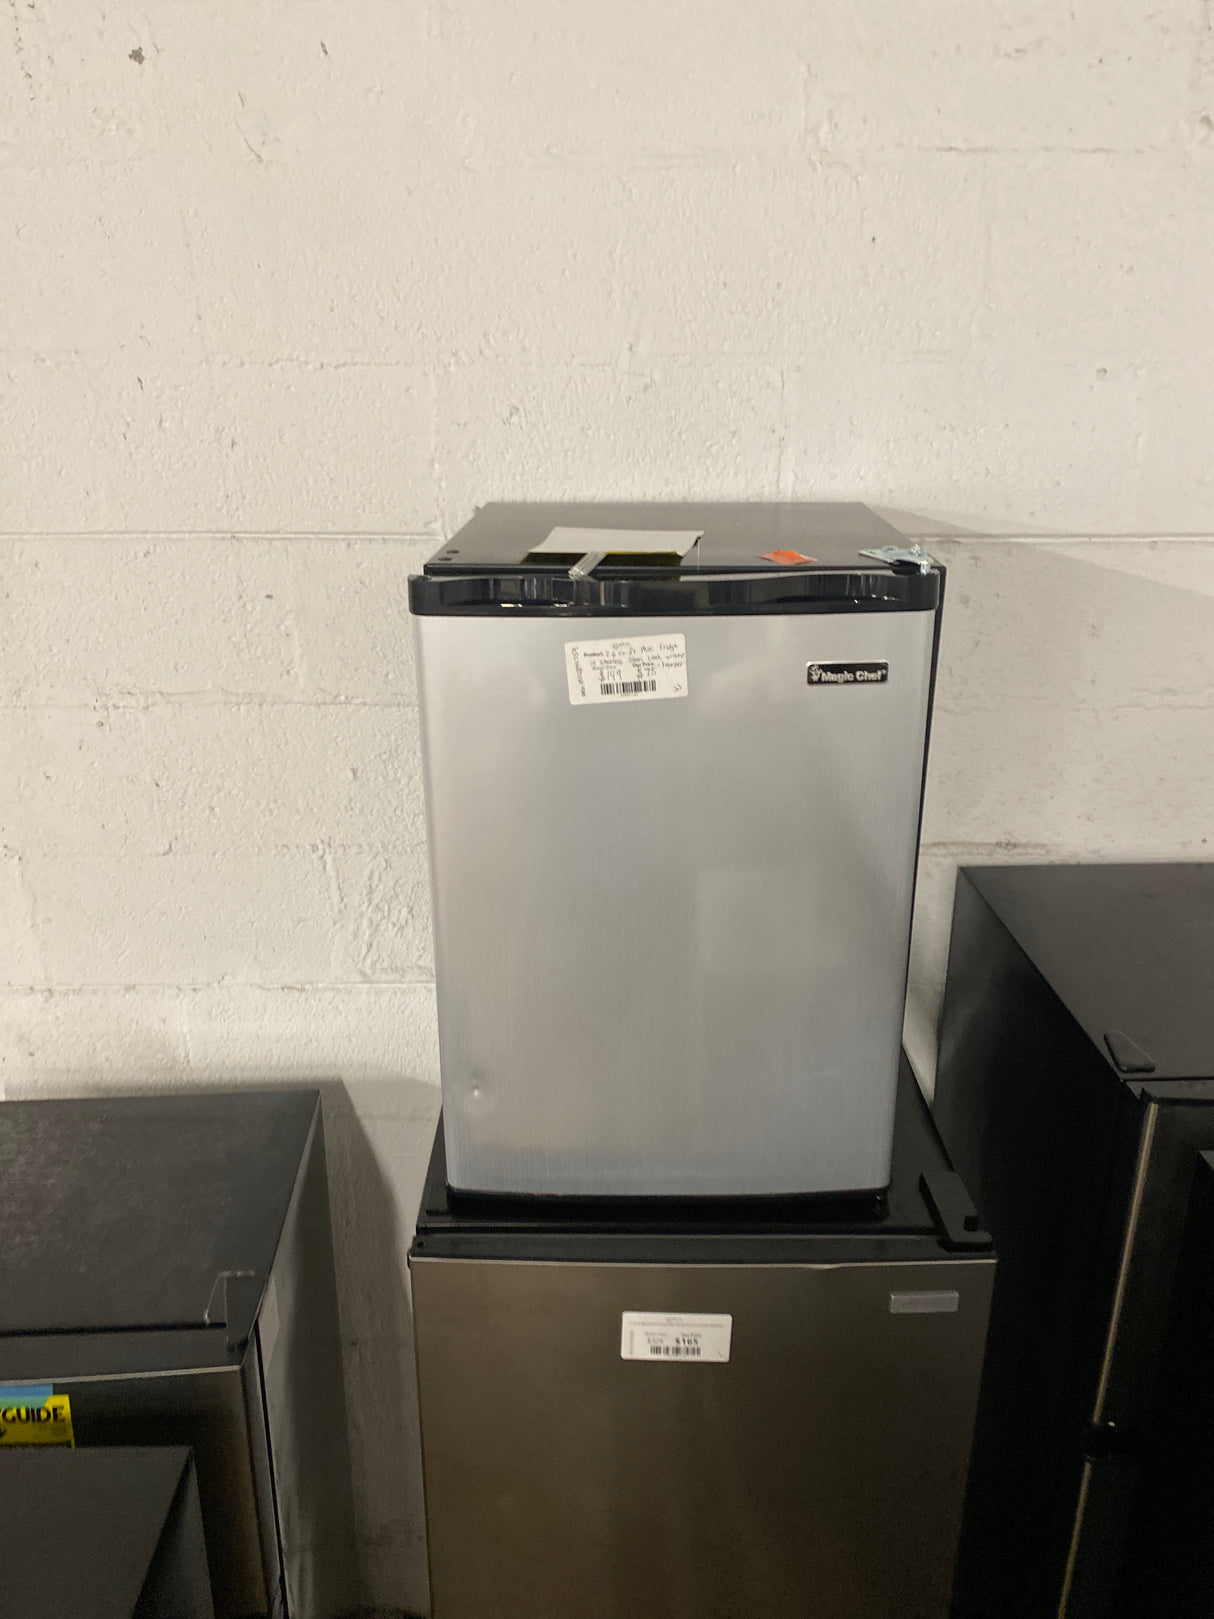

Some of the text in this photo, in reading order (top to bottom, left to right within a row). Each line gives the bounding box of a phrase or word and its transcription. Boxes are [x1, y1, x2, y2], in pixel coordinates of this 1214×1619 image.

[821, 669, 882, 684] Magic Chef
[0, 1406, 65, 1422] GUIDE
